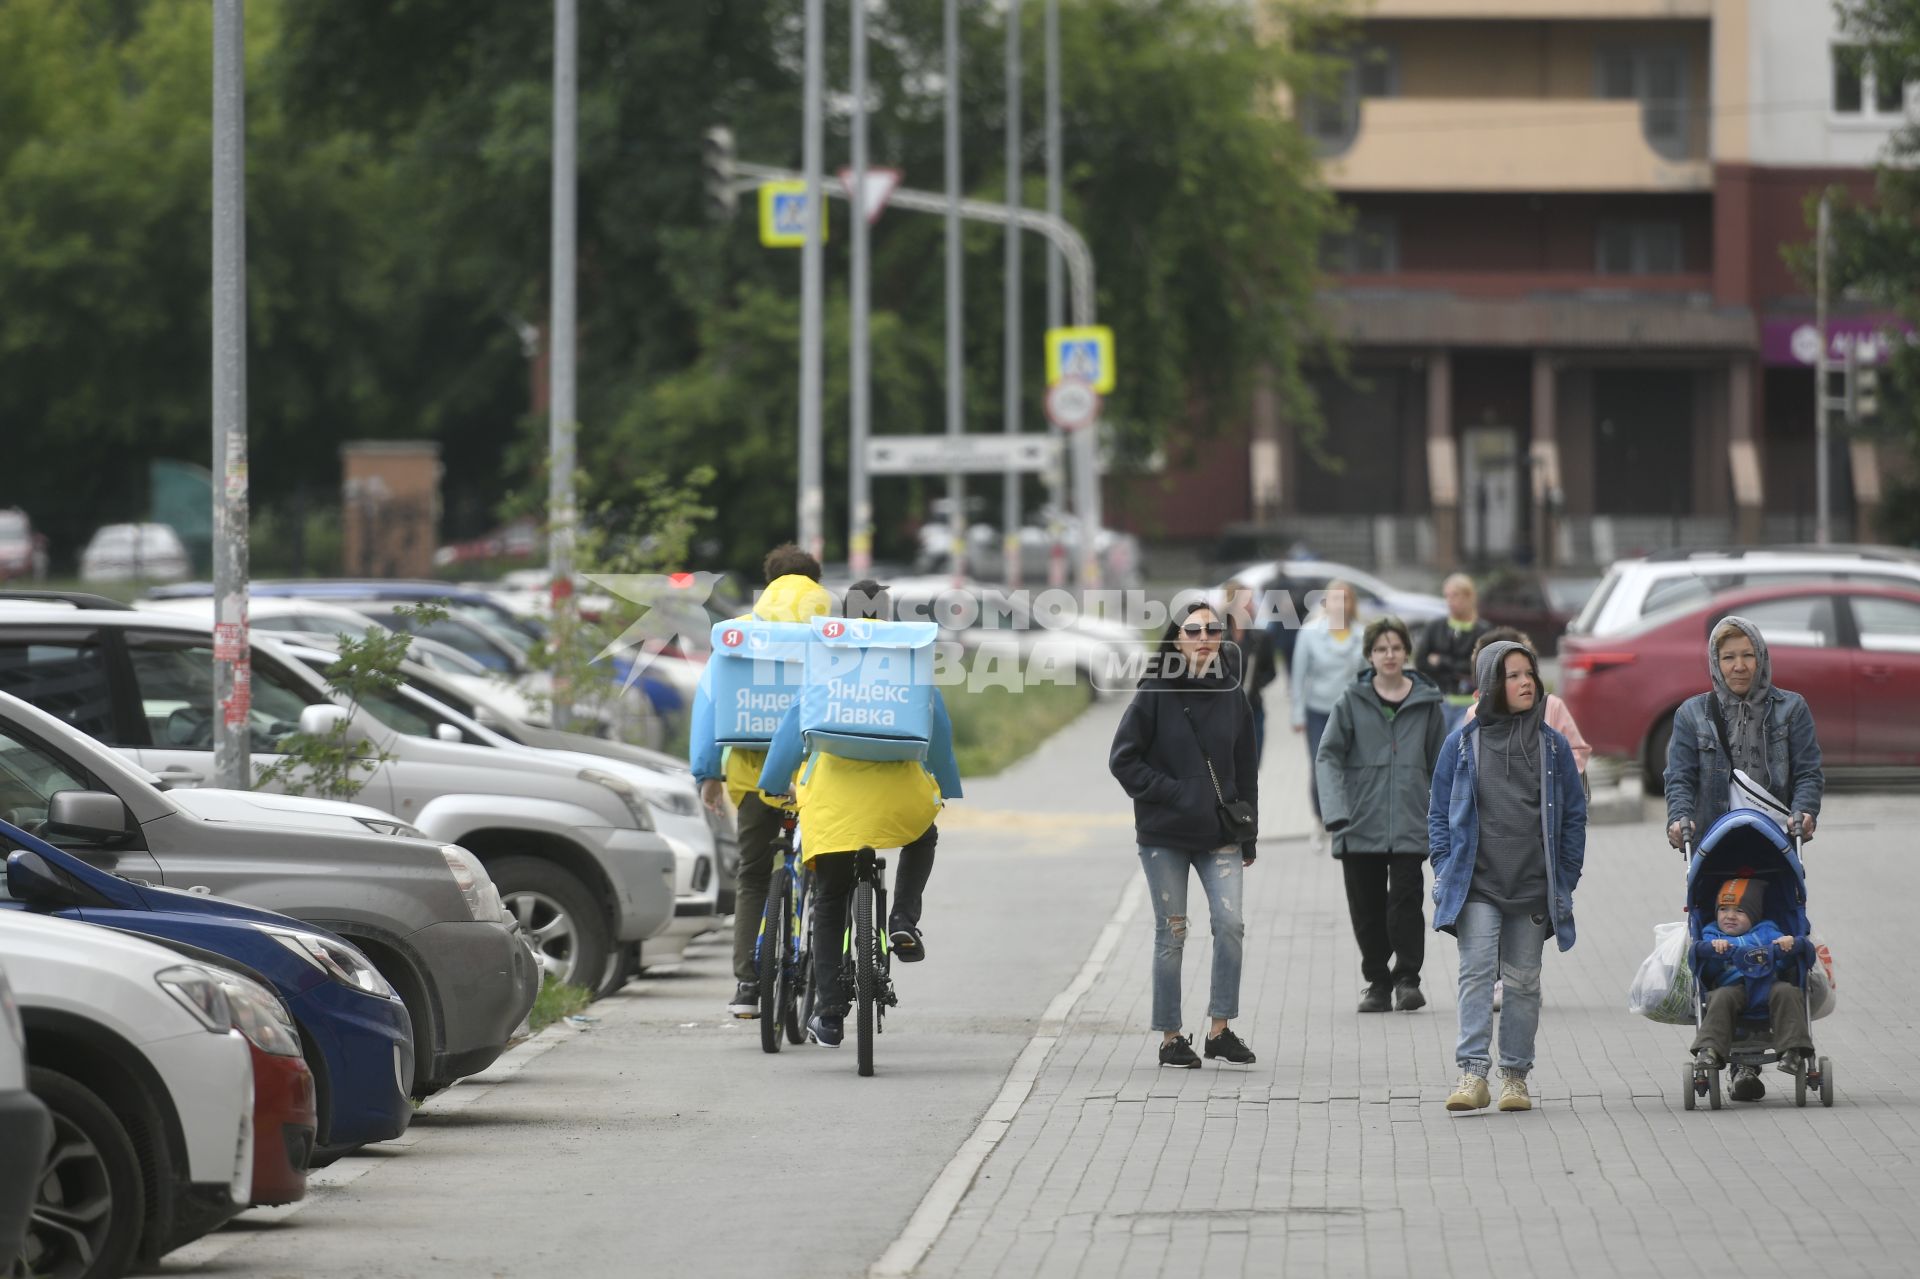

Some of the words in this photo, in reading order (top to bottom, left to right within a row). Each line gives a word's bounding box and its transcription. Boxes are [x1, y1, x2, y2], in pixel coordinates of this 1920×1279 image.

[727, 631, 738, 644] Я
[827, 623, 839, 636] Я
[826, 678, 910, 704] Яндекс
[823, 702, 895, 727] Лавка
